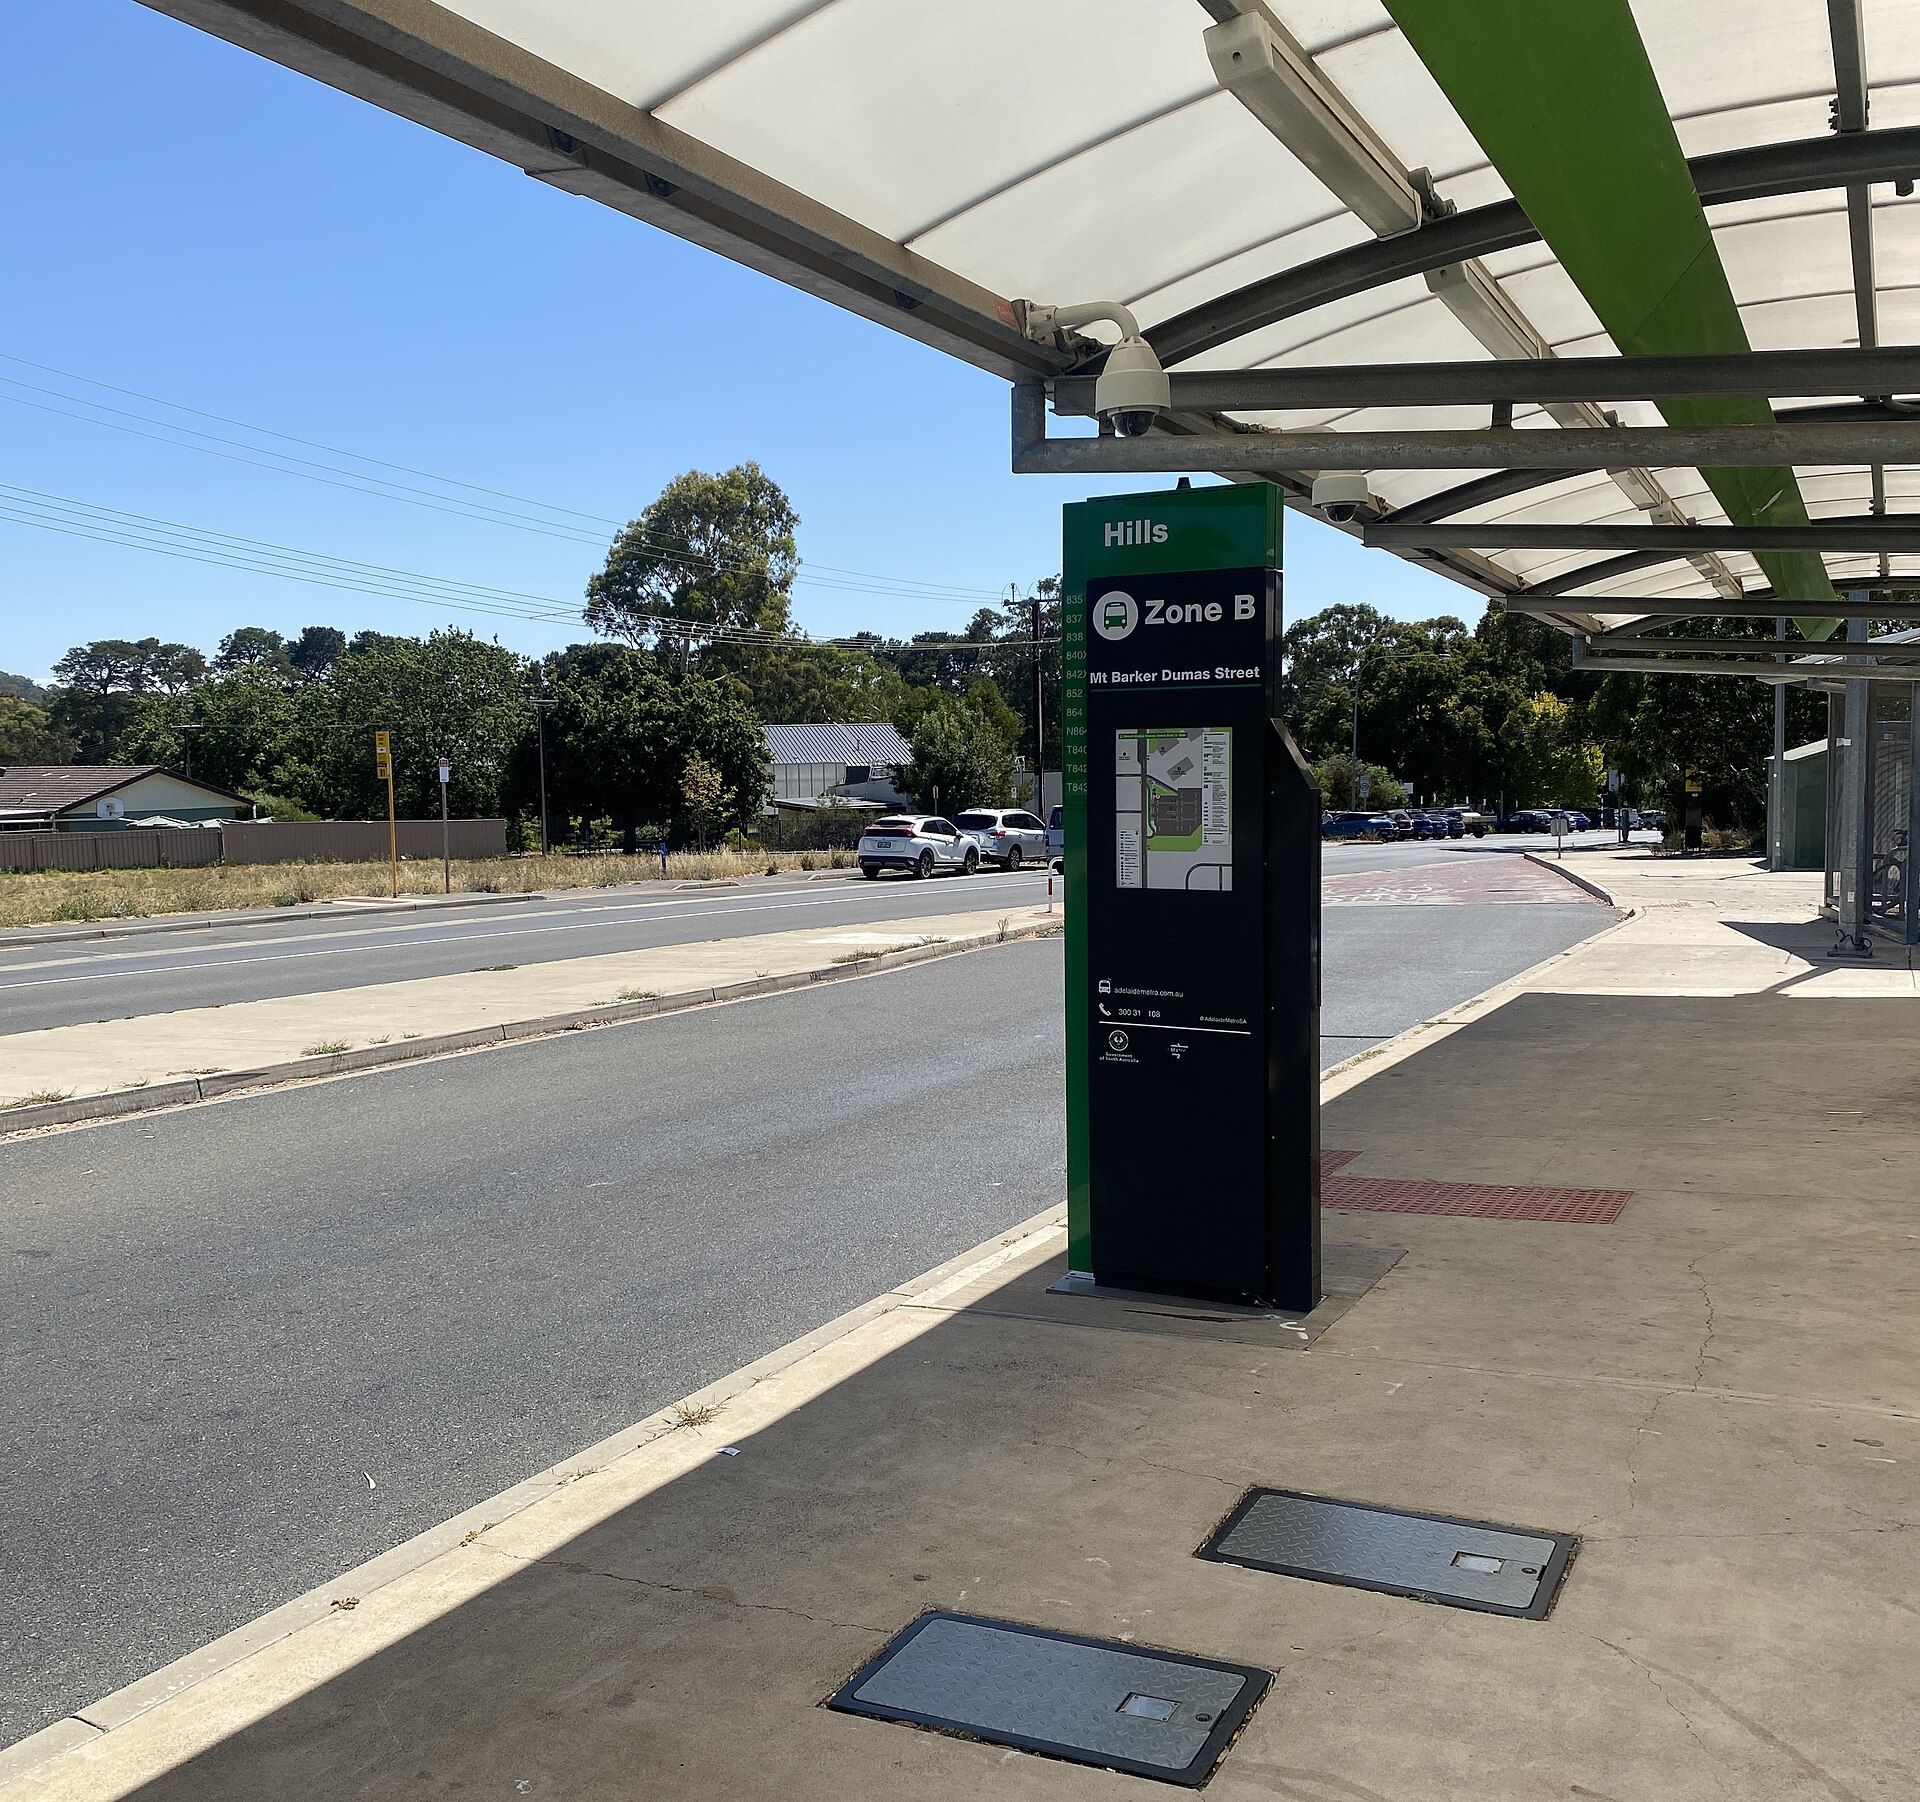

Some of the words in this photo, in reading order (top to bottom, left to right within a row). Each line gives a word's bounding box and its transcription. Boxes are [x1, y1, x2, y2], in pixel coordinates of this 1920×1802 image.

[1104, 519, 1168, 547] Hills
[1066, 595, 1083, 604] 835
[1144, 598, 1223, 625] Zone
[1234, 594, 1256, 620] B
[1066, 614, 1083, 624] 837
[1066, 632, 1084, 642] 838
[1090, 670, 1108, 684] Mt
[1111, 668, 1158, 684] Barker
[1161, 668, 1211, 682] Dumas
[1214, 666, 1260, 680] Street
[1066, 688, 1083, 698] 852
[1066, 707, 1083, 717] 864
[1113, 987, 1184, 997] adelaidemetro.com.au
